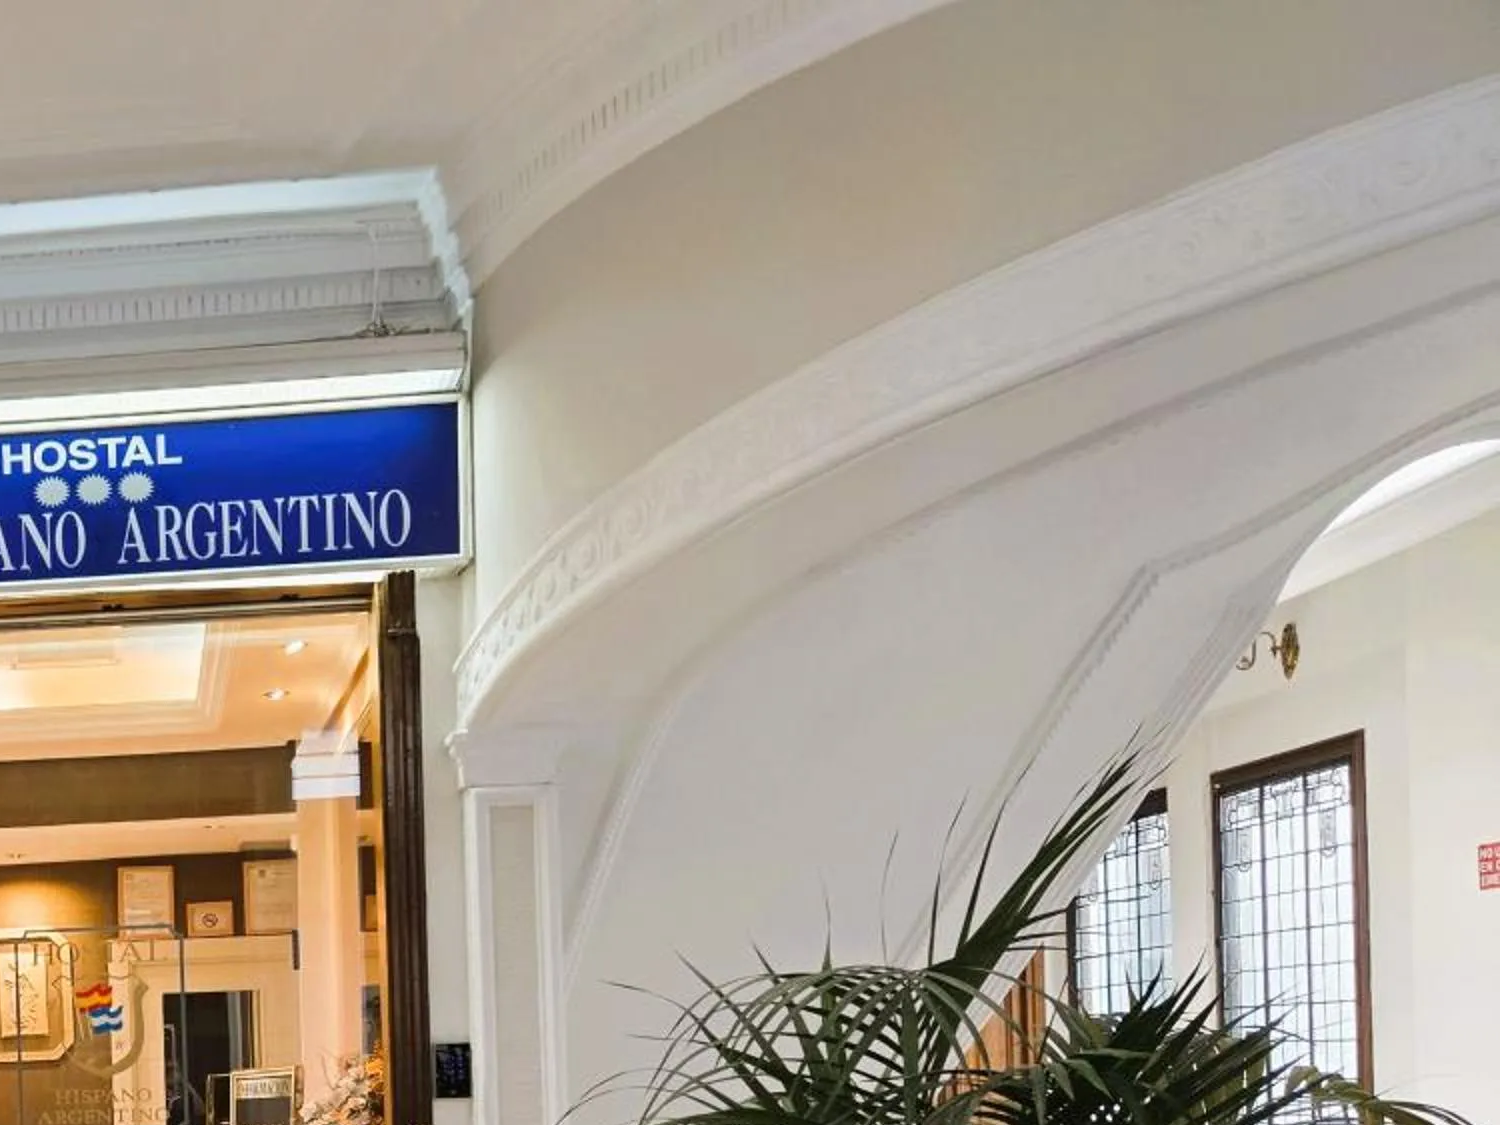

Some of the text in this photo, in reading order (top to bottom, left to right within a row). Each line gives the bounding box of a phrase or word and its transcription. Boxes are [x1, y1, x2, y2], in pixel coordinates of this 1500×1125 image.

[2, 433, 182, 475] HOSTAL
[117, 489, 411, 564] ARGENTINO
[54, 1087, 152, 1106] HISPANO
